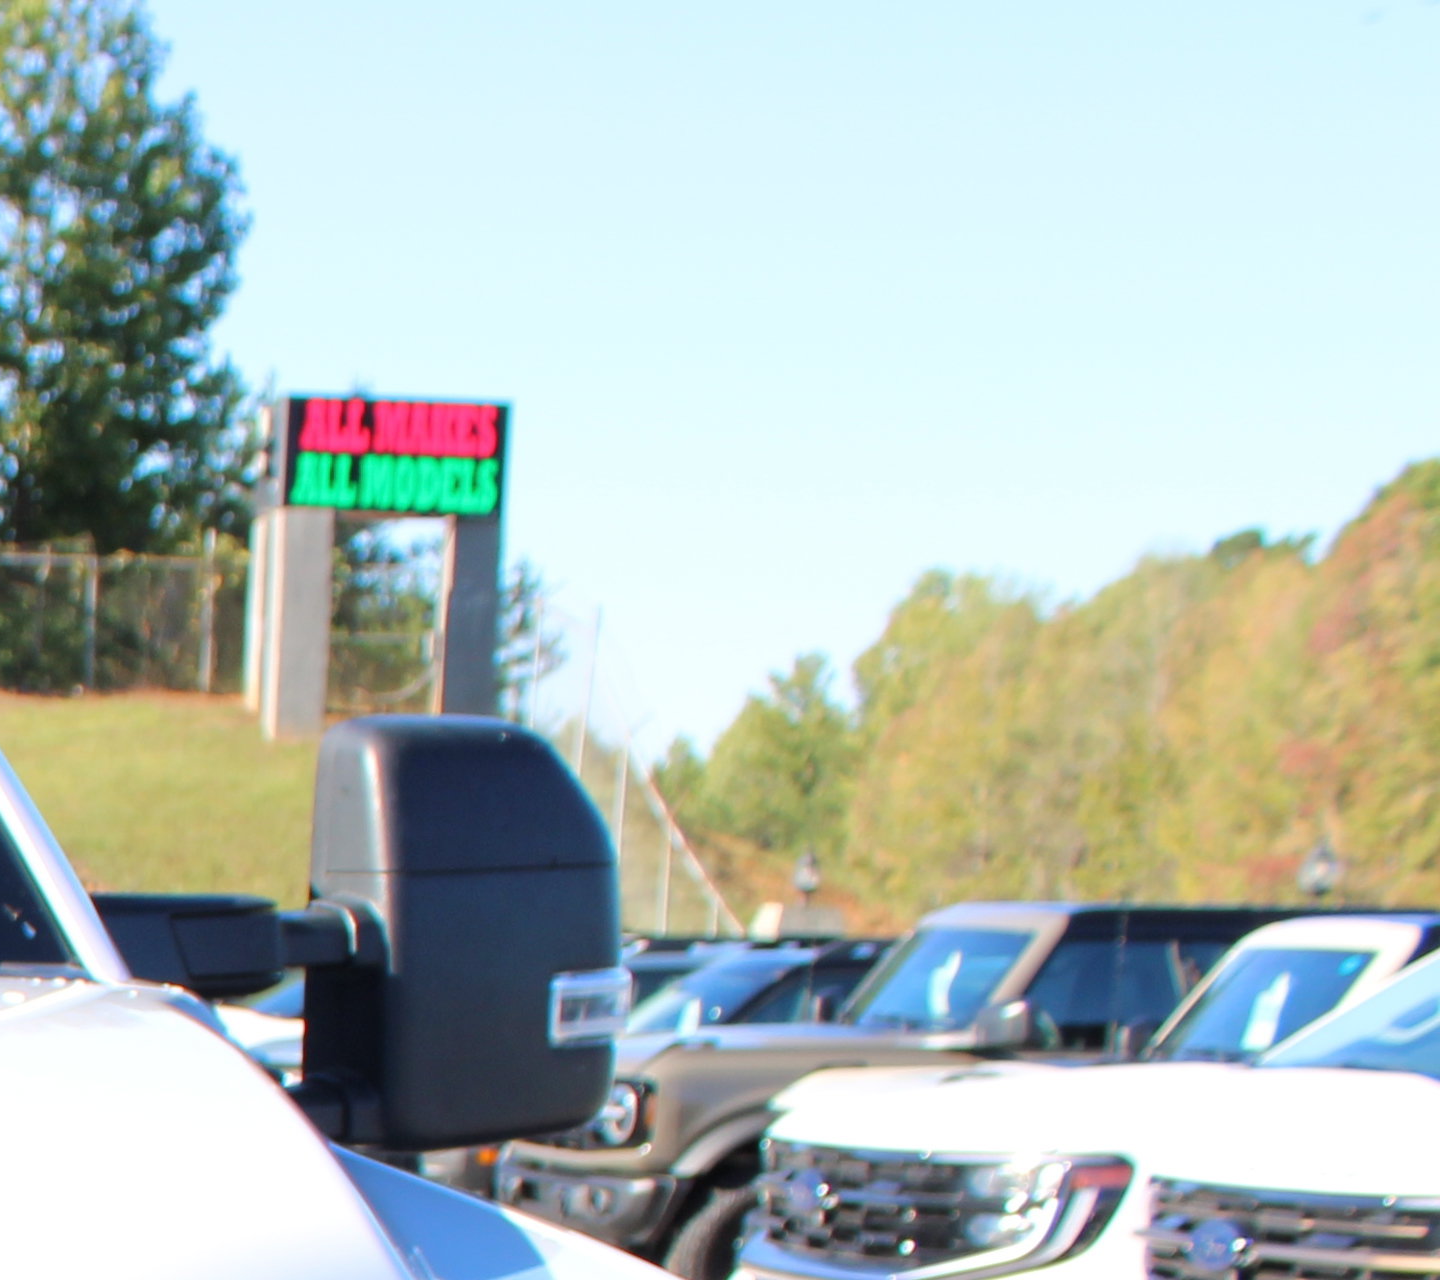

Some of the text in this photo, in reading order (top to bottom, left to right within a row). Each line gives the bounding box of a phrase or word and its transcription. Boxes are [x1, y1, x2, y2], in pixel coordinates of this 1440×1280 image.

[298, 396, 499, 459] ALL MAKES
[289, 451, 499, 514] ALL MODELS
